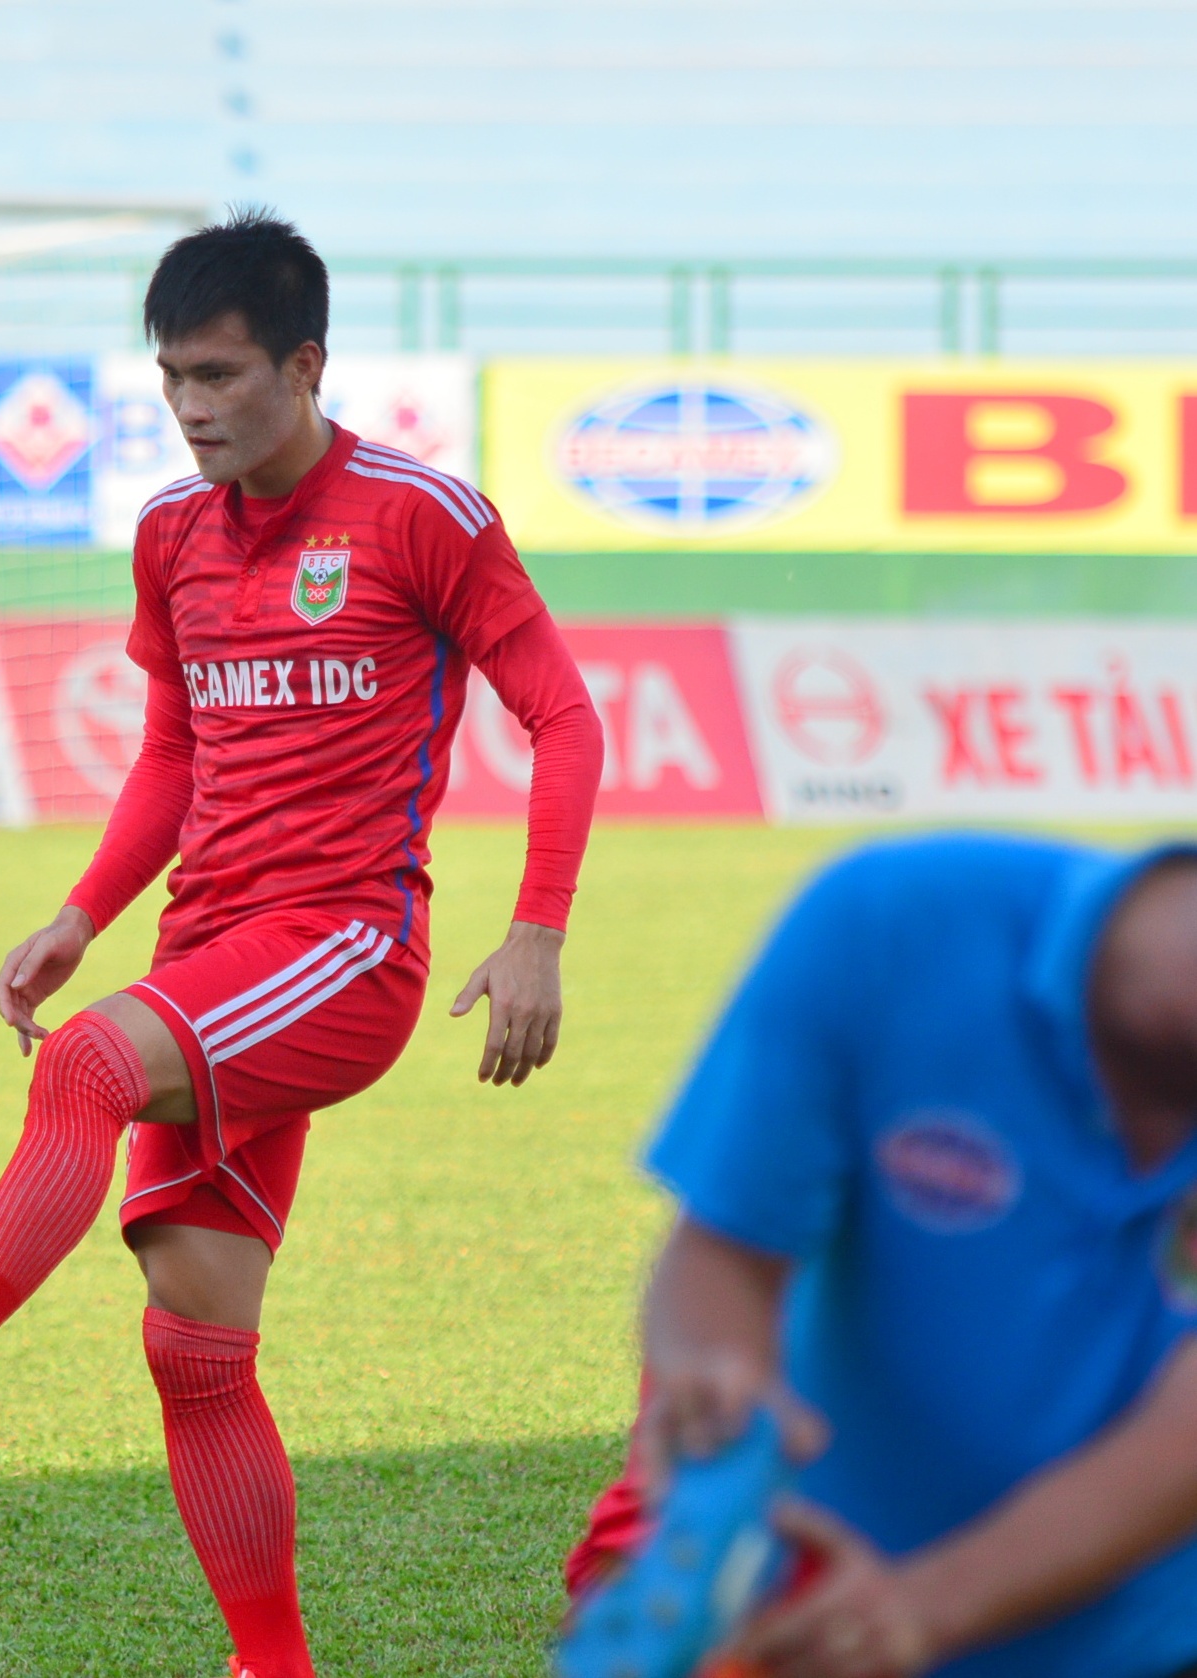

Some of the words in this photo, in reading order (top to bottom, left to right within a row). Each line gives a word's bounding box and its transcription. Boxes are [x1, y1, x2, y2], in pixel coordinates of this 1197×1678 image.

[900, 391, 1197, 516] B
[309, 656, 378, 705] IDC
[922, 684, 1046, 788] XE
